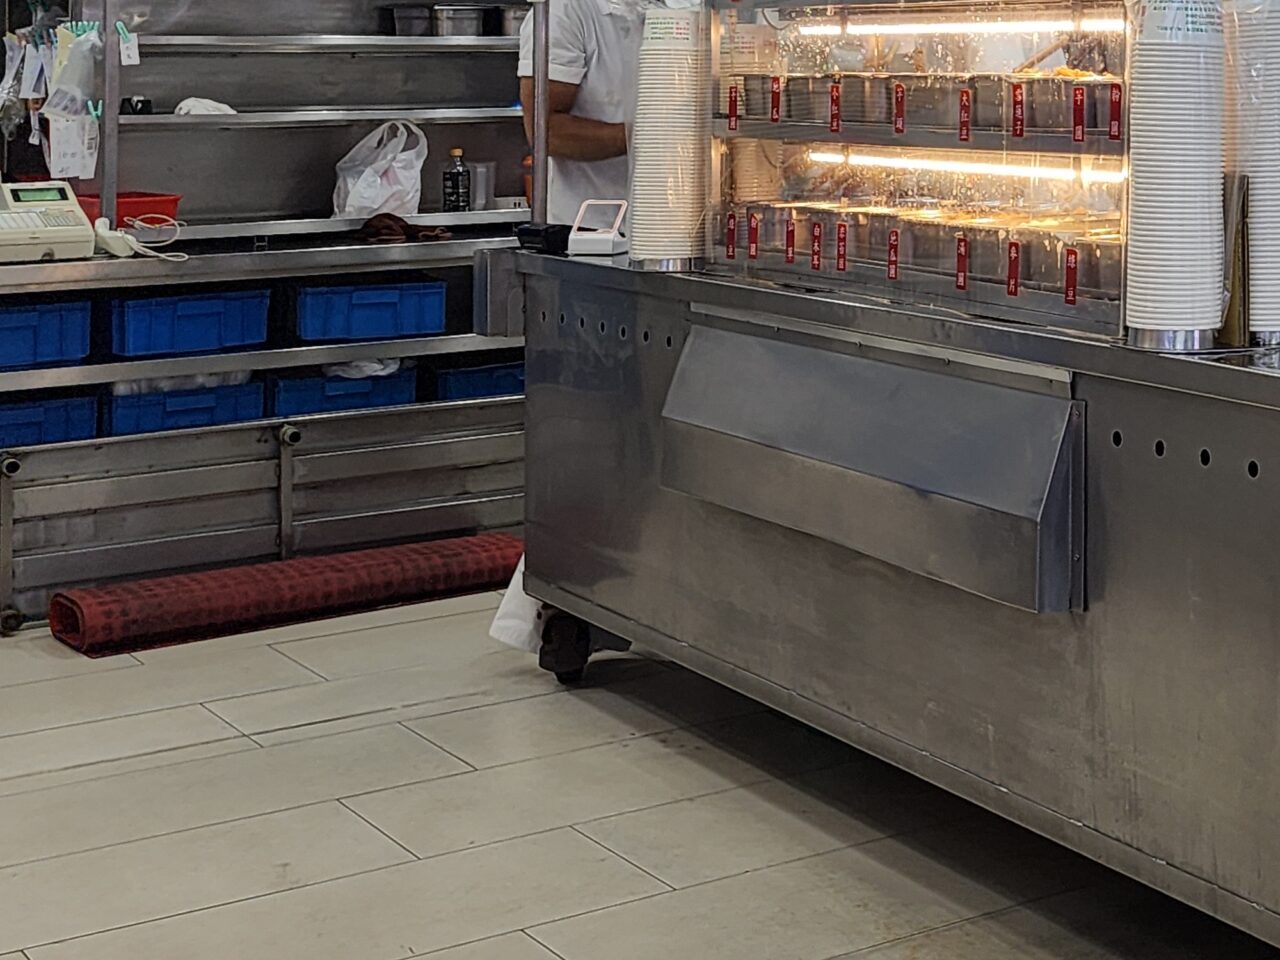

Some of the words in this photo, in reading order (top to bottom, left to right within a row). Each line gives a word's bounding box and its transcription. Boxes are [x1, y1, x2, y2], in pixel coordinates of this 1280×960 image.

[960, 93, 970, 139] 大紅豆
[1074, 89, 1084, 140] 芋圓
